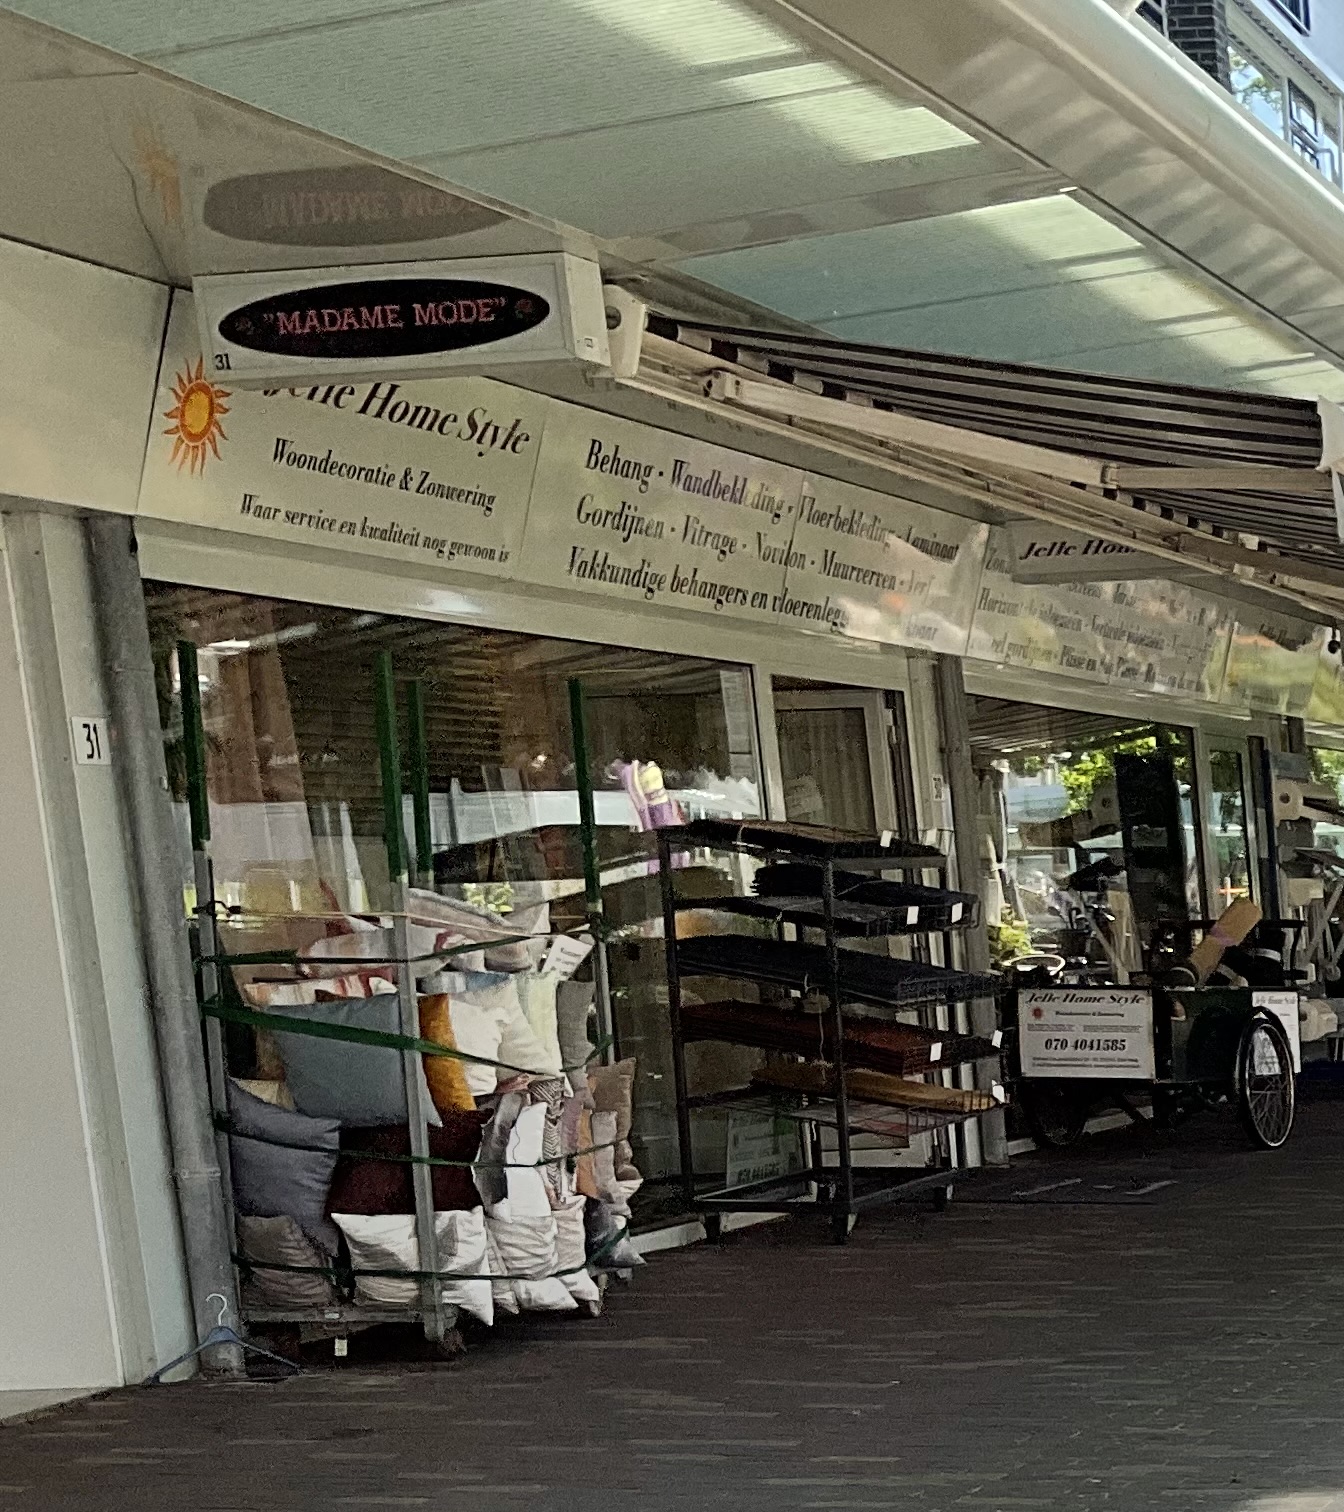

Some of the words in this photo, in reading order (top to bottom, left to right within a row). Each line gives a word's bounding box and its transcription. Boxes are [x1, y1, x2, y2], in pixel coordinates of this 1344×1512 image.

[214, 354, 232, 371] 31
[356, 382, 457, 436] Home
[456, 406, 530, 457] Style
[272, 437, 396, 488] Woondecoratie
[399, 466, 413, 491] &
[415, 470, 497, 517] Zonwering
[584, 438, 655, 494] Behang
[240, 493, 282, 521] Waar
[283, 509, 337, 532] service
[338, 518, 357, 536] en
[360, 517, 420, 548] kwaliteit
[422, 535, 448, 559] nog
[448, 539, 496, 561] gewoon
[499, 544, 510, 562] is
[577, 493, 665, 543] Gordijnen
[682, 515, 738, 562] Vitrage
[818, 549, 896, 591] Muurverven
[1019, 541, 1077, 561] Jelle
[567, 545, 667, 600] Vakkundige
[670, 564, 749, 611] behangers
[751, 589, 768, 610] en
[82, 723, 101, 760] 31
[1061, 992, 1102, 1004] Home
[1045, 1038, 1070, 1051] 070
